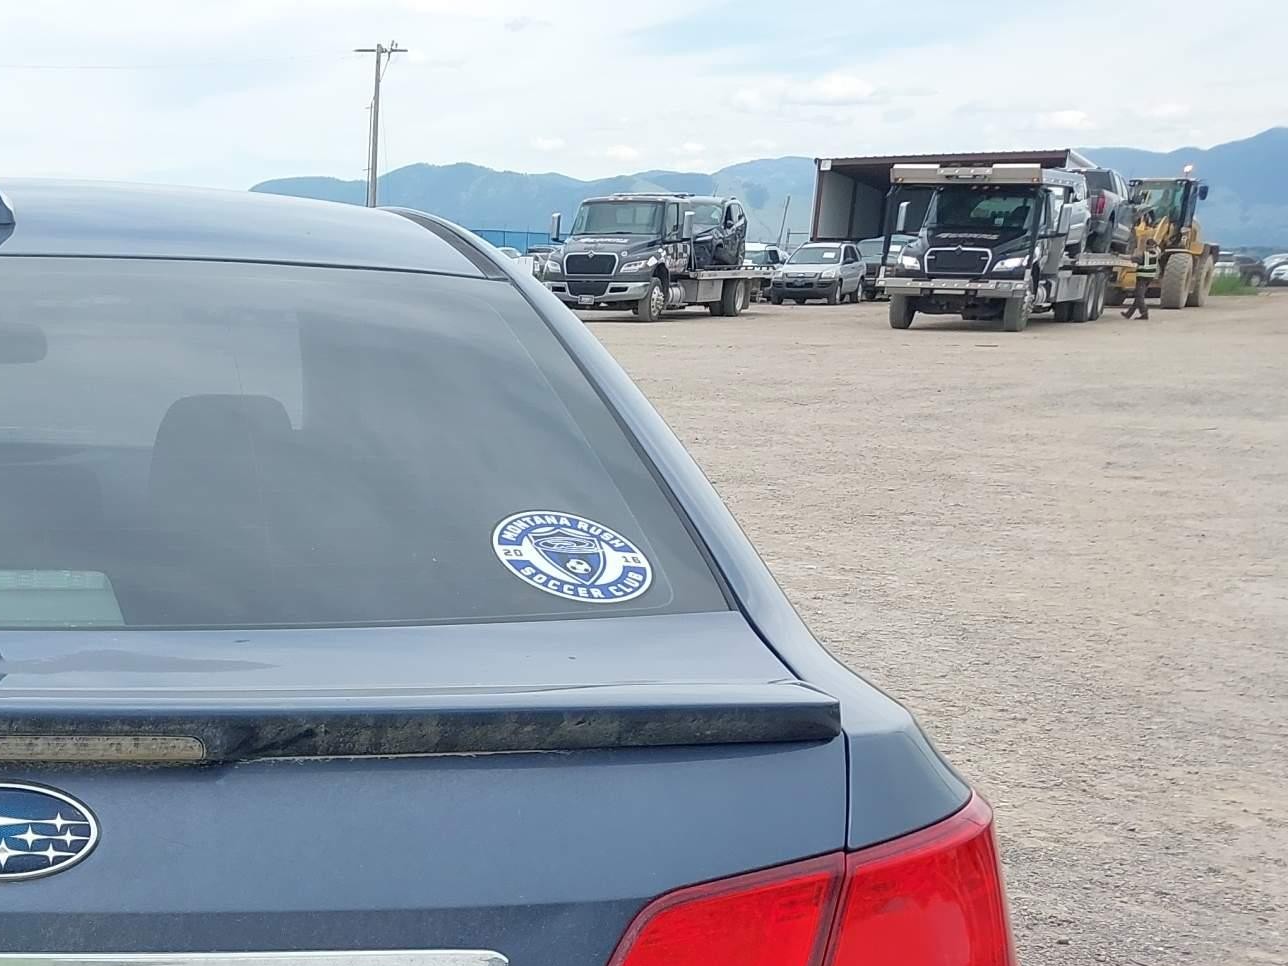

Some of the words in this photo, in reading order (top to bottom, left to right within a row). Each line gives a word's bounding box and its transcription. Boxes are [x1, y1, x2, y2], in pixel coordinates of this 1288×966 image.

[501, 514, 572, 542] MONTANA
[577, 520, 625, 549] RUSH
[503, 548, 523, 557] 20
[520, 566, 605, 599] SOCCER
[608, 571, 644, 597] CLUB
